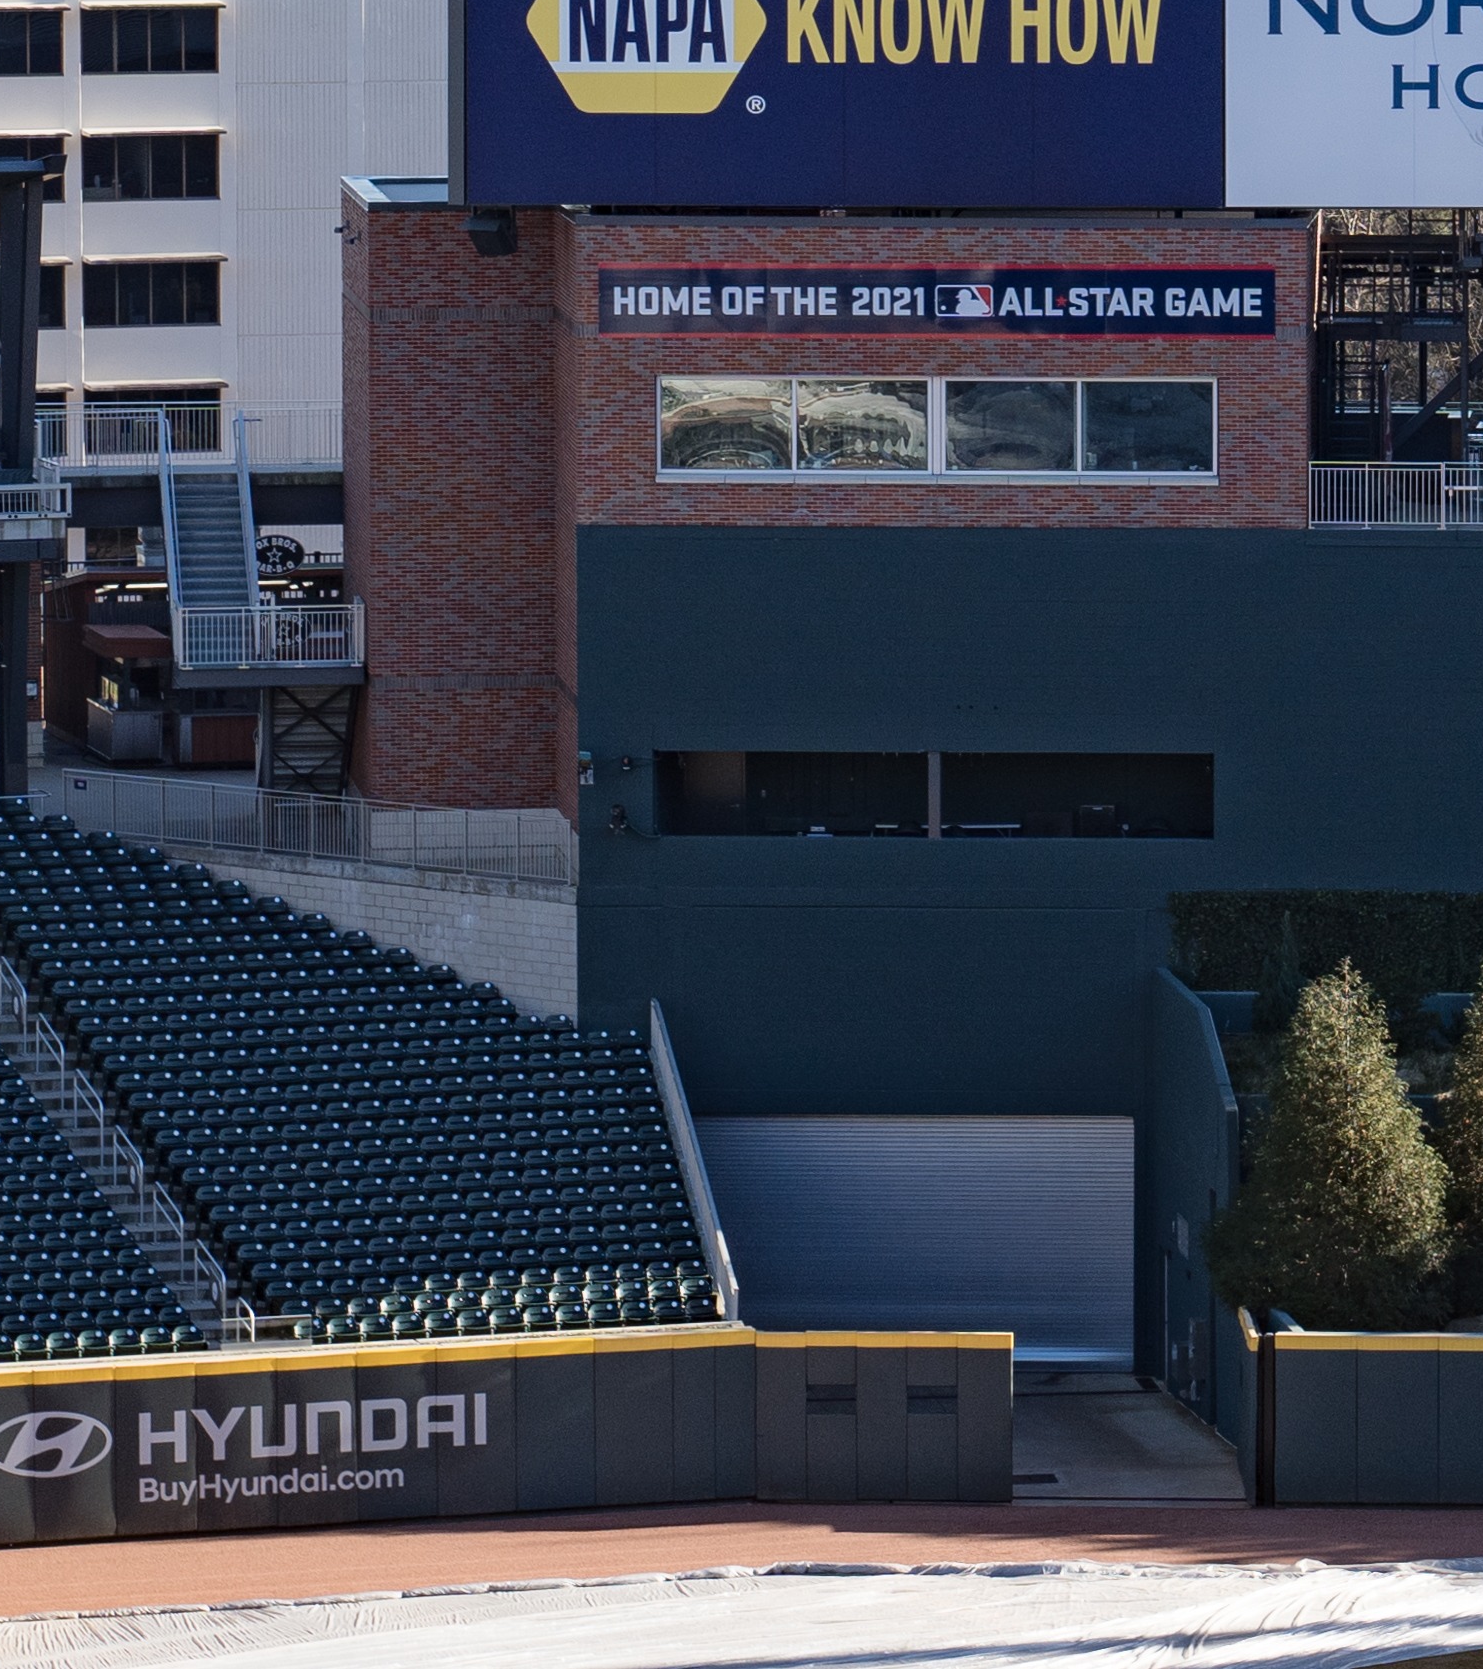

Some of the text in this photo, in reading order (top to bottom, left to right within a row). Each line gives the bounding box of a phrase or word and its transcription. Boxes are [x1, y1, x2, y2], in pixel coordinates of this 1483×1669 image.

[613, 286, 712, 317] HOME
[721, 286, 766, 317] OF
[771, 286, 838, 318] THE
[852, 286, 926, 318] 2021
[1165, 287, 1263, 319] GAME
[138, 1393, 488, 1466] HYUNDAI
[138, 1466, 405, 1507] BuyHyundai.com
